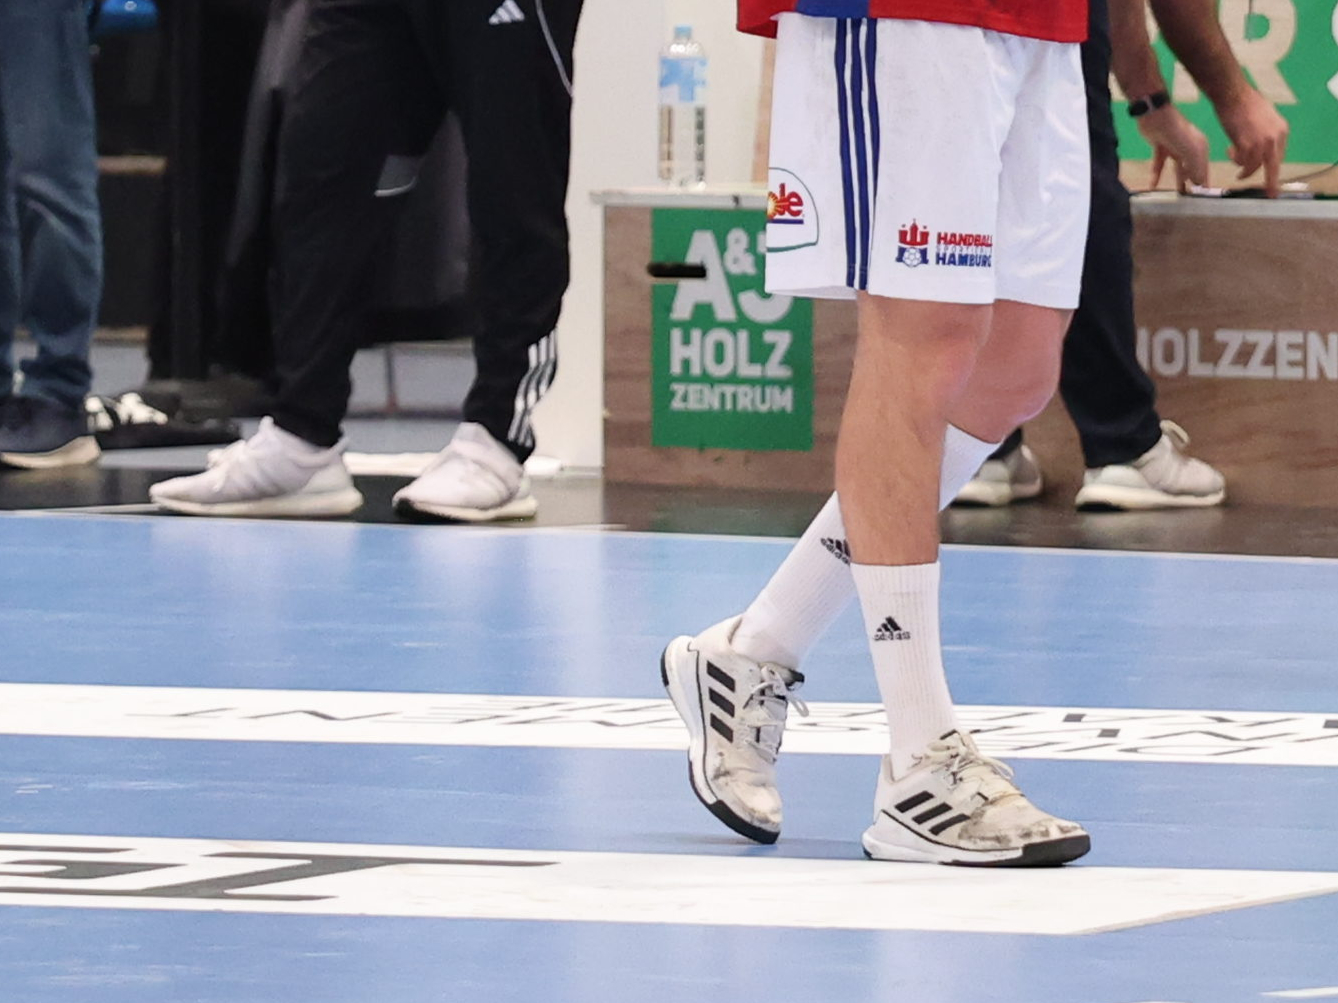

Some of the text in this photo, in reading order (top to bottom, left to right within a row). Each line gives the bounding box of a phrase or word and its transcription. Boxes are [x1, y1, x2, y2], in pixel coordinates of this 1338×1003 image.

[937, 231, 993, 246] HANDBALL
[670, 327, 793, 378] HOLZ
[670, 383, 794, 413] ZENTRUM
[820, 538, 850, 566] adida
[874, 631, 911, 642] adidas
